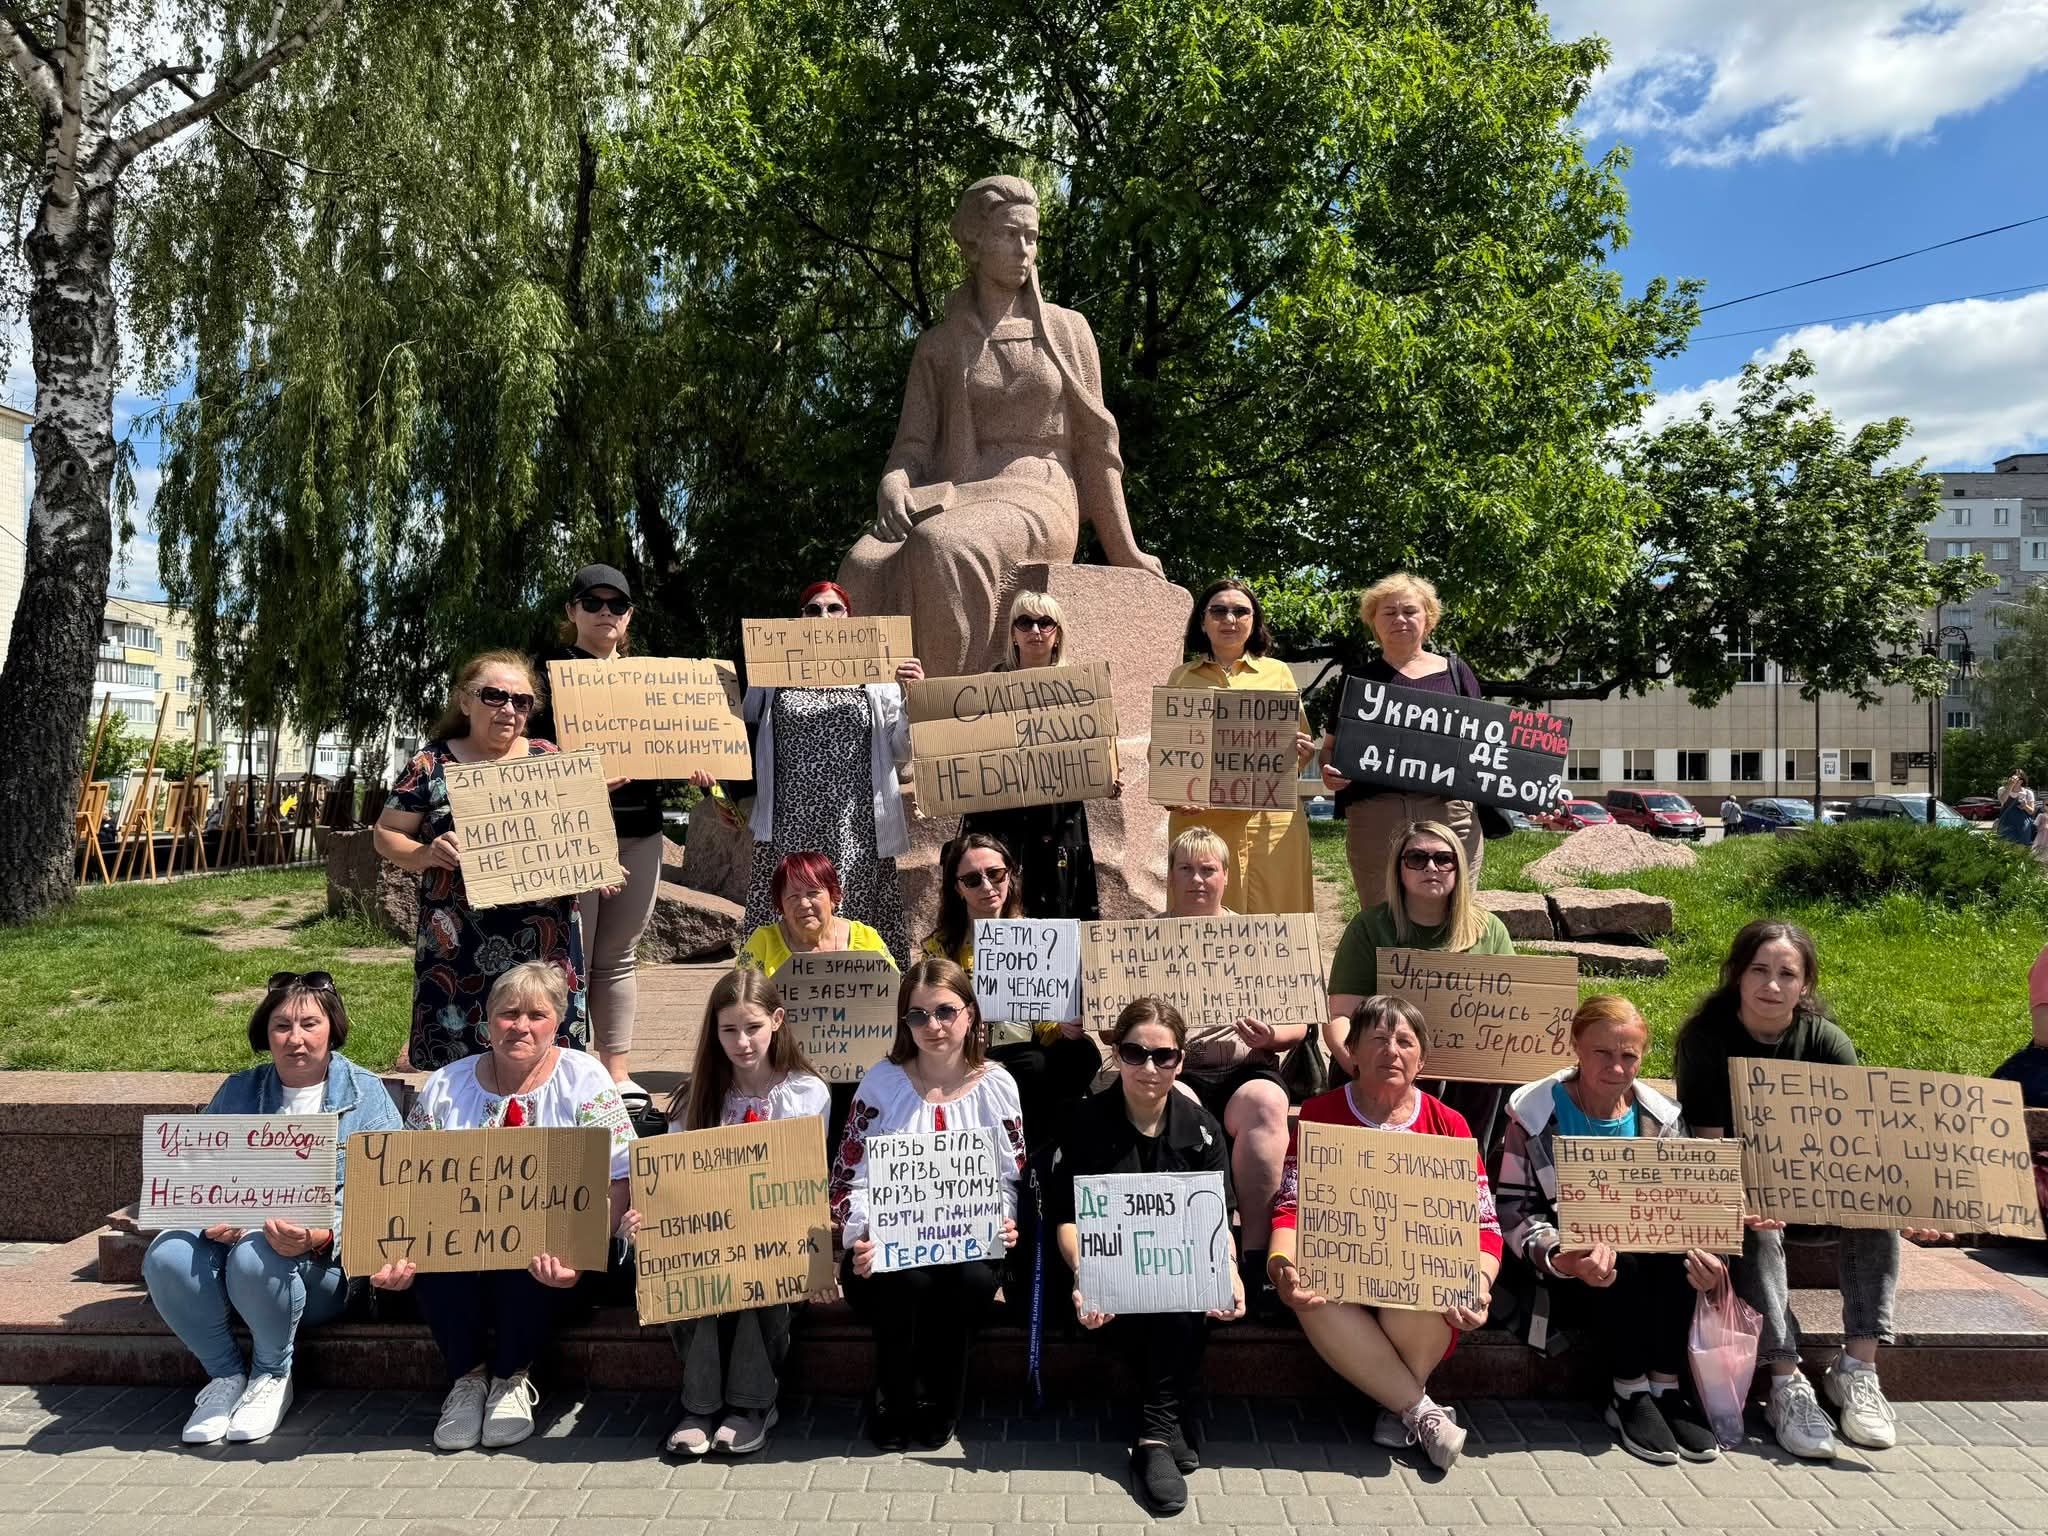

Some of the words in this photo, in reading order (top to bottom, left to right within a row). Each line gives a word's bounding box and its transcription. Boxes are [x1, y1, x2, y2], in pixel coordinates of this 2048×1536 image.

[645, 692, 667, 707] НЕ
[673, 691, 736, 707] СМЕРТЬ
[953, 678, 1096, 723] СИГНАЛЬ
[1166, 696, 1229, 720] БУДЬ
[1239, 698, 1300, 721] ПОРУЧ
[1508, 709, 1563, 733] МАТИ
[1217, 729, 1278, 748] ТИМИ
[1510, 726, 1569, 755] ГЕРОЇВ
[1159, 749, 1205, 769] ХТО
[1215, 752, 1285, 773] ЧЕКАЄ
[1468, 742, 1509, 770] ДЕ
[453, 769, 485, 790] ЗА
[499, 756, 593, 785] КОЖНИМ
[551, 809, 590, 836] ЯКА
[478, 851, 508, 873] НЕ
[522, 836, 600, 865] СПИТЬ
[511, 863, 604, 895] НОЧАМИ
[1090, 924, 1160, 943] БУТИ
[792, 959, 815, 975] НЕ
[825, 959, 891, 973] ЗРАДИТИ
[1111, 945, 1189, 964] НАШИХ
[977, 974, 998, 995] МИ
[1086, 967, 1108, 984] ЦЕ
[1125, 965, 1149, 979] НЕ
[1165, 961, 1237, 978] ДАТИ
[808, 983, 889, 999] ЗАБУТИ
[1747, 1066, 1848, 1100] ДЕНЬ
[1791, 1105, 1841, 1126] ПРО
[1934, 1111, 2010, 1138] КОГО
[157, 1122, 229, 1157] Ціна
[1564, 1141, 1636, 1163] Наша
[1742, 1131, 1783, 1154] МИ
[1358, 1150, 1376, 1169] НЕ
[1383, 1152, 1478, 1183] ЗНИКАЮТЬ
[1934, 1167, 1976, 1189] НЕ
[1123, 1193, 1176, 1217] ЗАРАЗ
[1304, 1177, 1337, 1205] БЕЗ
[1423, 1197, 1478, 1224] ВОНИ
[1933, 1196, 2038, 1228] ЛЮБИТИ
[878, 1209, 924, 1227] БУТИ
[1303, 1207, 1367, 1237] ЖИВУТЬ
[1373, 1215, 1386, 1241] У
[917, 1223, 972, 1241] НАШИХ
[1402, 1250, 1416, 1281] У
[666, 1273, 732, 1315] ВОНИ
[1334, 1272, 1344, 1299] У
[1357, 1275, 1421, 1304] НАШОМУ
